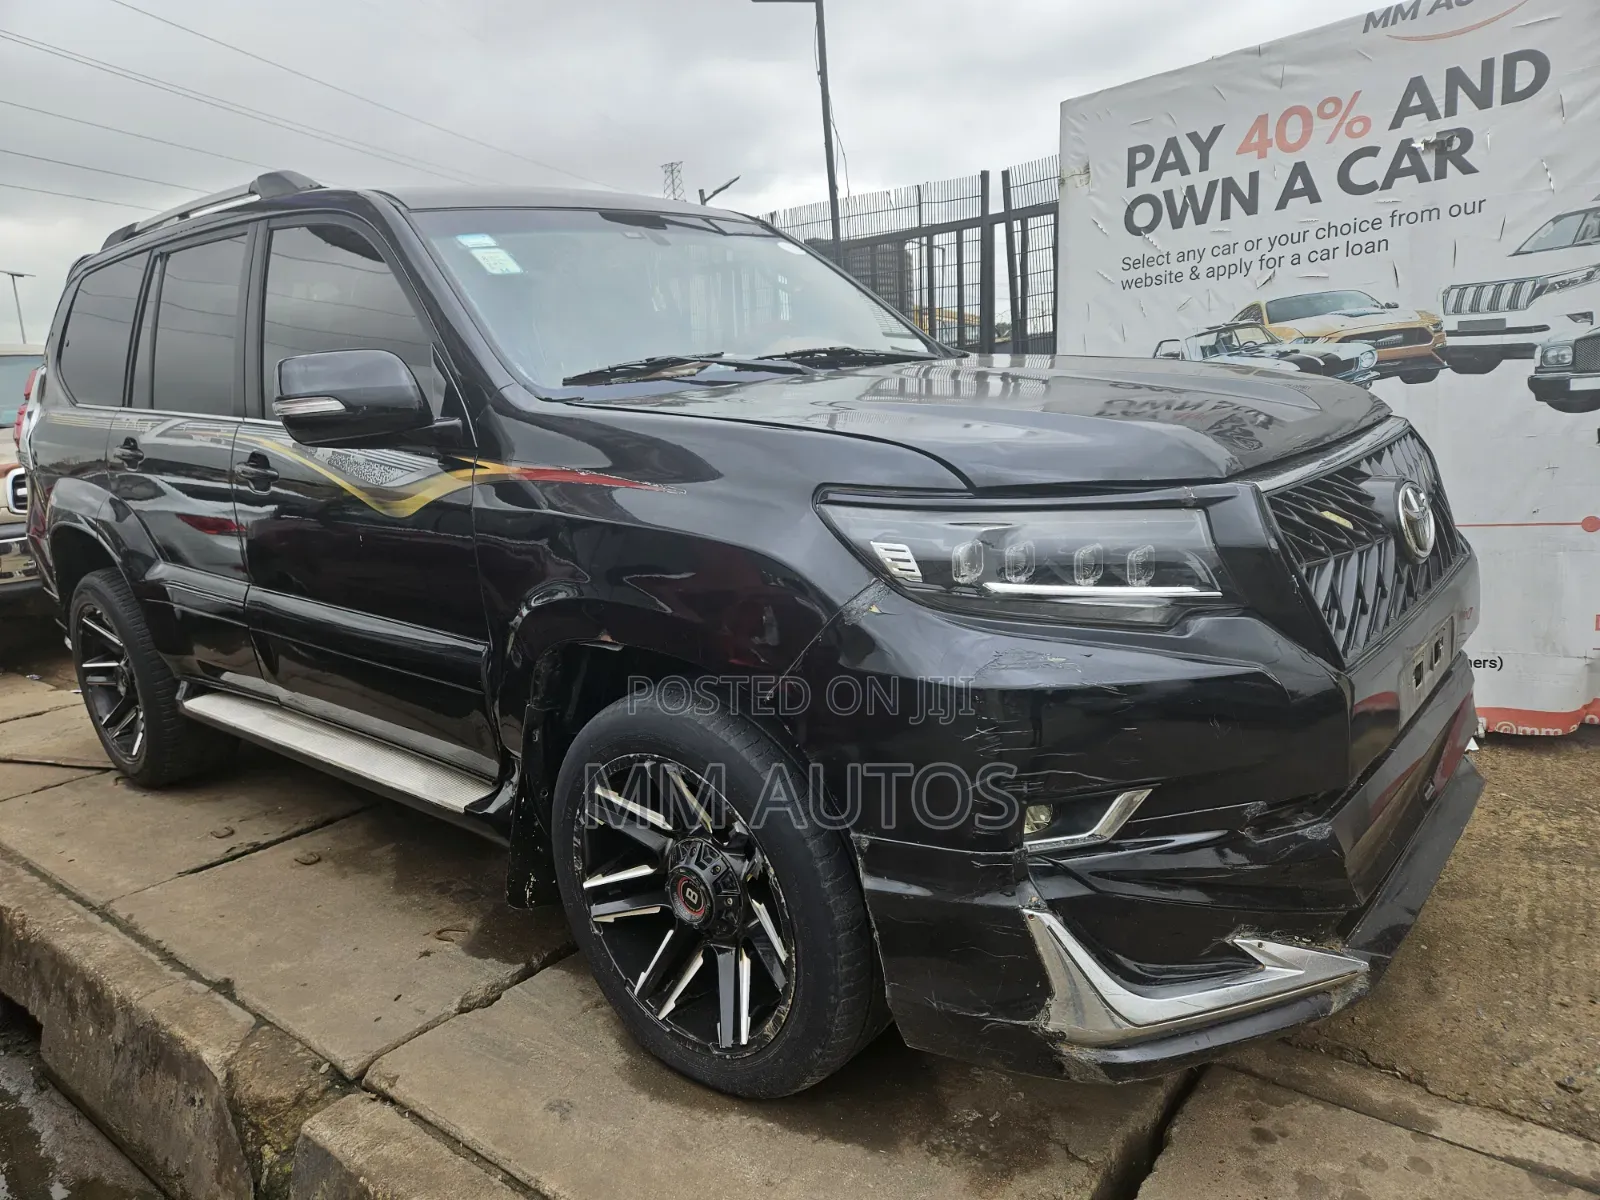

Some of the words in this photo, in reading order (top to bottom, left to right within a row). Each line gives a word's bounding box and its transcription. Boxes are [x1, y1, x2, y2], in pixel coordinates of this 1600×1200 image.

[1362, 0, 1421, 34] MM
[1126, 123, 1226, 189] PAY
[1235, 90, 1372, 160] 40%
[1388, 49, 1551, 131] AND
[1124, 170, 1260, 237] OWN
[1274, 160, 1323, 211] A
[1337, 127, 1480, 196] CAR
[1121, 250, 1172, 272] Select
[1176, 247, 1206, 264] any
[1211, 241, 1239, 258] car
[1244, 237, 1263, 252] or
[1267, 229, 1310, 252] your
[1315, 217, 1383, 240] choice
[1389, 208, 1441, 228] from
[1448, 198, 1487, 218] our
[1121, 269, 1184, 290] website
[1189, 265, 1201, 281] &
[1205, 257, 1253, 281] apply
[1258, 253, 1285, 271] for
[1290, 252, 1301, 266] a
[1307, 245, 1340, 263] car
[1345, 238, 1389, 258] loan
